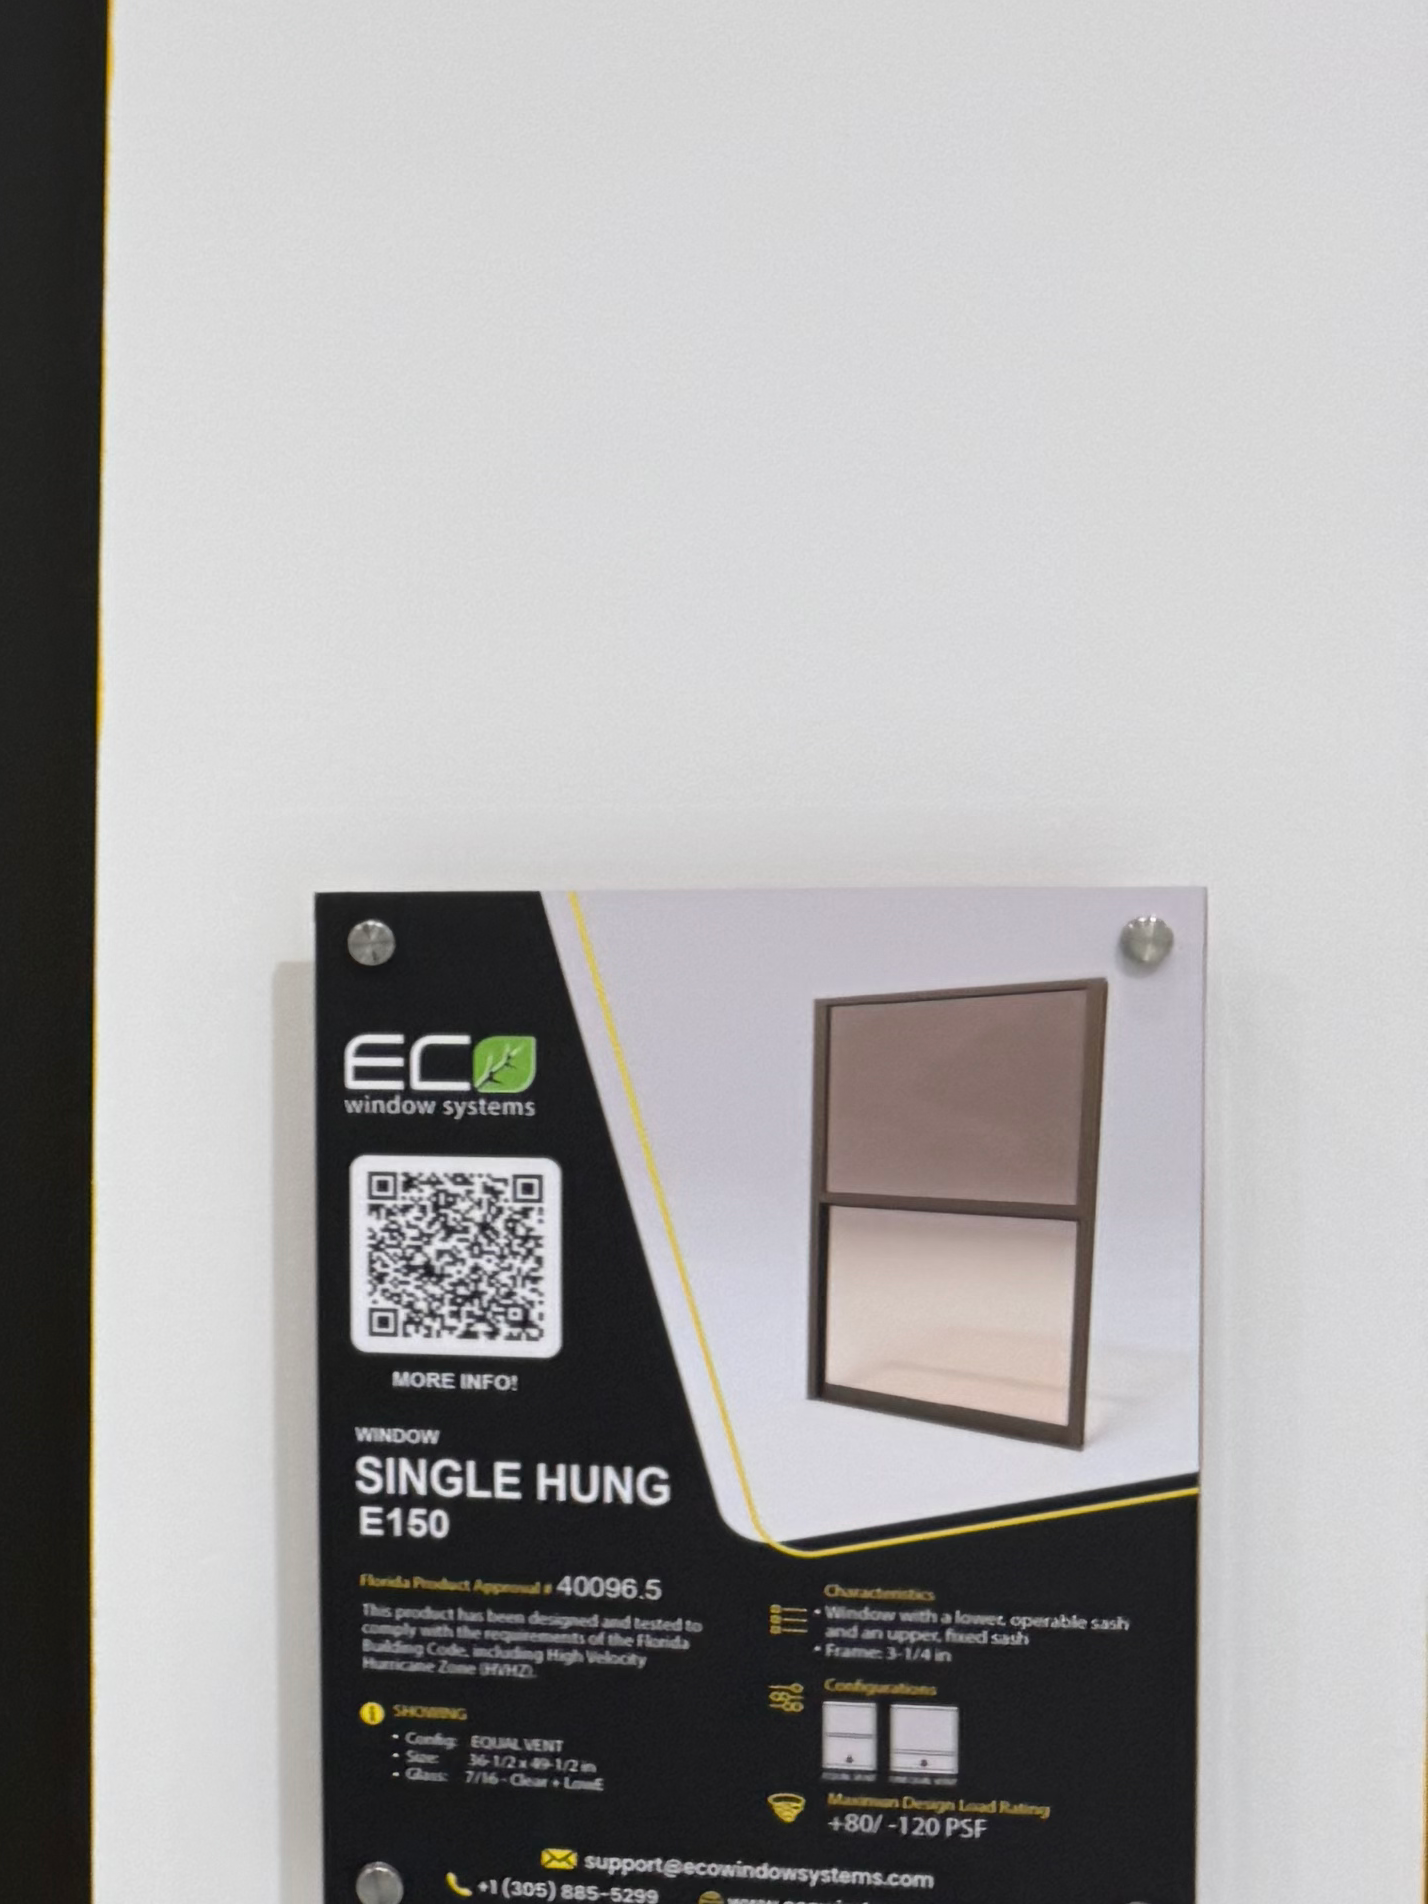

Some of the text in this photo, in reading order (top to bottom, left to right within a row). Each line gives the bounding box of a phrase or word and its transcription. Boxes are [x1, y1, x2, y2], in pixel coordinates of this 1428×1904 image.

[343, 1094, 536, 1120] window systems
[391, 1370, 519, 1392] MORE INFO!
[354, 1426, 441, 1445] WINDOW
[354, 1455, 672, 1507] SINGLE HUNG
[358, 1505, 450, 1539] E150
[555, 1575, 663, 1601] 40096.5
[823, 1583, 937, 1602] Characteristics
[362, 1602, 704, 1633] This product has been designed and tested to
[824, 1604, 1130, 1632] Window with a lower, operable sash
[360, 1622, 690, 1650] comply with the requirements of the Florida
[824, 1623, 1030, 1646] and an upper, fixed sash
[361, 1638, 425, 1659] Building
[472, 1644, 544, 1666] including
[546, 1648, 585, 1667] High
[585, 1649, 648, 1670] Velocity
[824, 1642, 953, 1663] Frame: 3-1/4 in
[361, 1655, 437, 1673] Hurricane
[438, 1659, 477, 1676] Zone
[823, 1677, 938, 1697] Configurations
[392, 1703, 467, 1721] SHOWING
[404, 1731, 564, 1753] Config: EQUAL VENT
[404, 1749, 440, 1765] Size:
[469, 1752, 518, 1770] 36-1/2
[518, 1759, 528, 1771] x
[580, 1759, 598, 1774] in
[404, 1767, 449, 1783] Glass:
[465, 1770, 500, 1786] 7/16
[509, 1772, 548, 1789] Clear
[563, 1777, 604, 1792] LowE
[901, 1795, 956, 1815] Design
[958, 1799, 997, 1814] Load
[998, 1800, 1051, 1820] Rating
[827, 1814, 988, 1839] +80/ -120 PSF
[584, 1855, 935, 1889] support@ecowindowsystems.com
[477, 1877, 660, 1904] +1 (305) 885-5299
